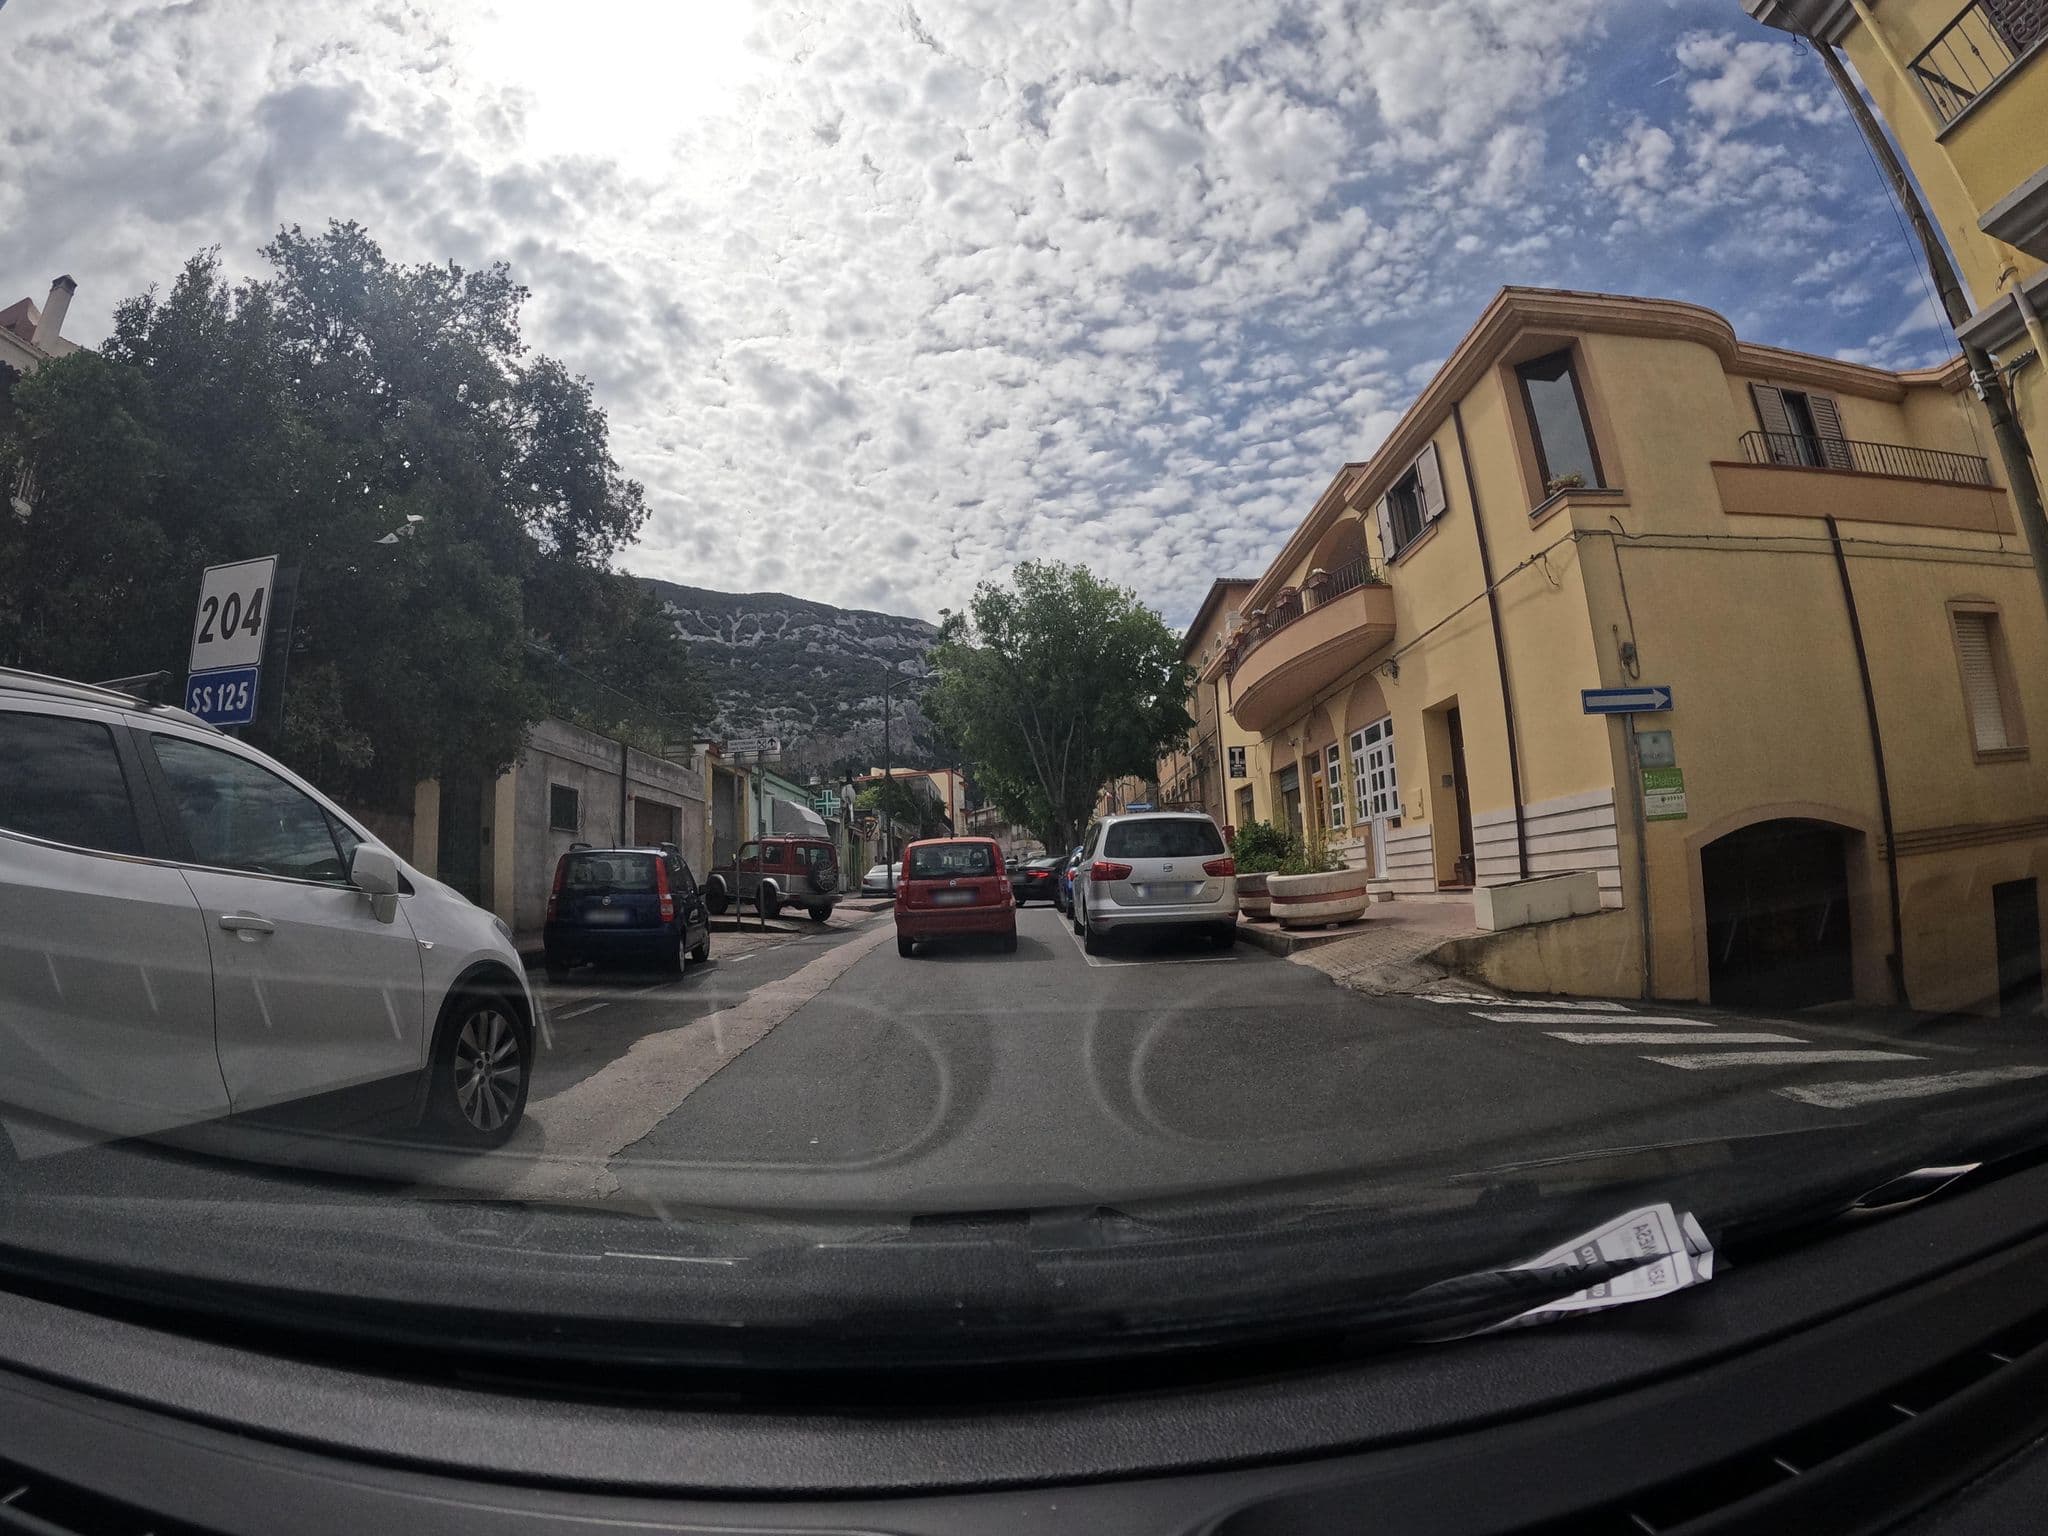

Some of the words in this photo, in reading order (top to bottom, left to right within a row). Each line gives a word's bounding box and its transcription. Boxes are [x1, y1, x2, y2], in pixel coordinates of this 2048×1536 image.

[198, 587, 265, 644] 204
[191, 686, 213, 713] SS
[217, 681, 249, 712] 125
